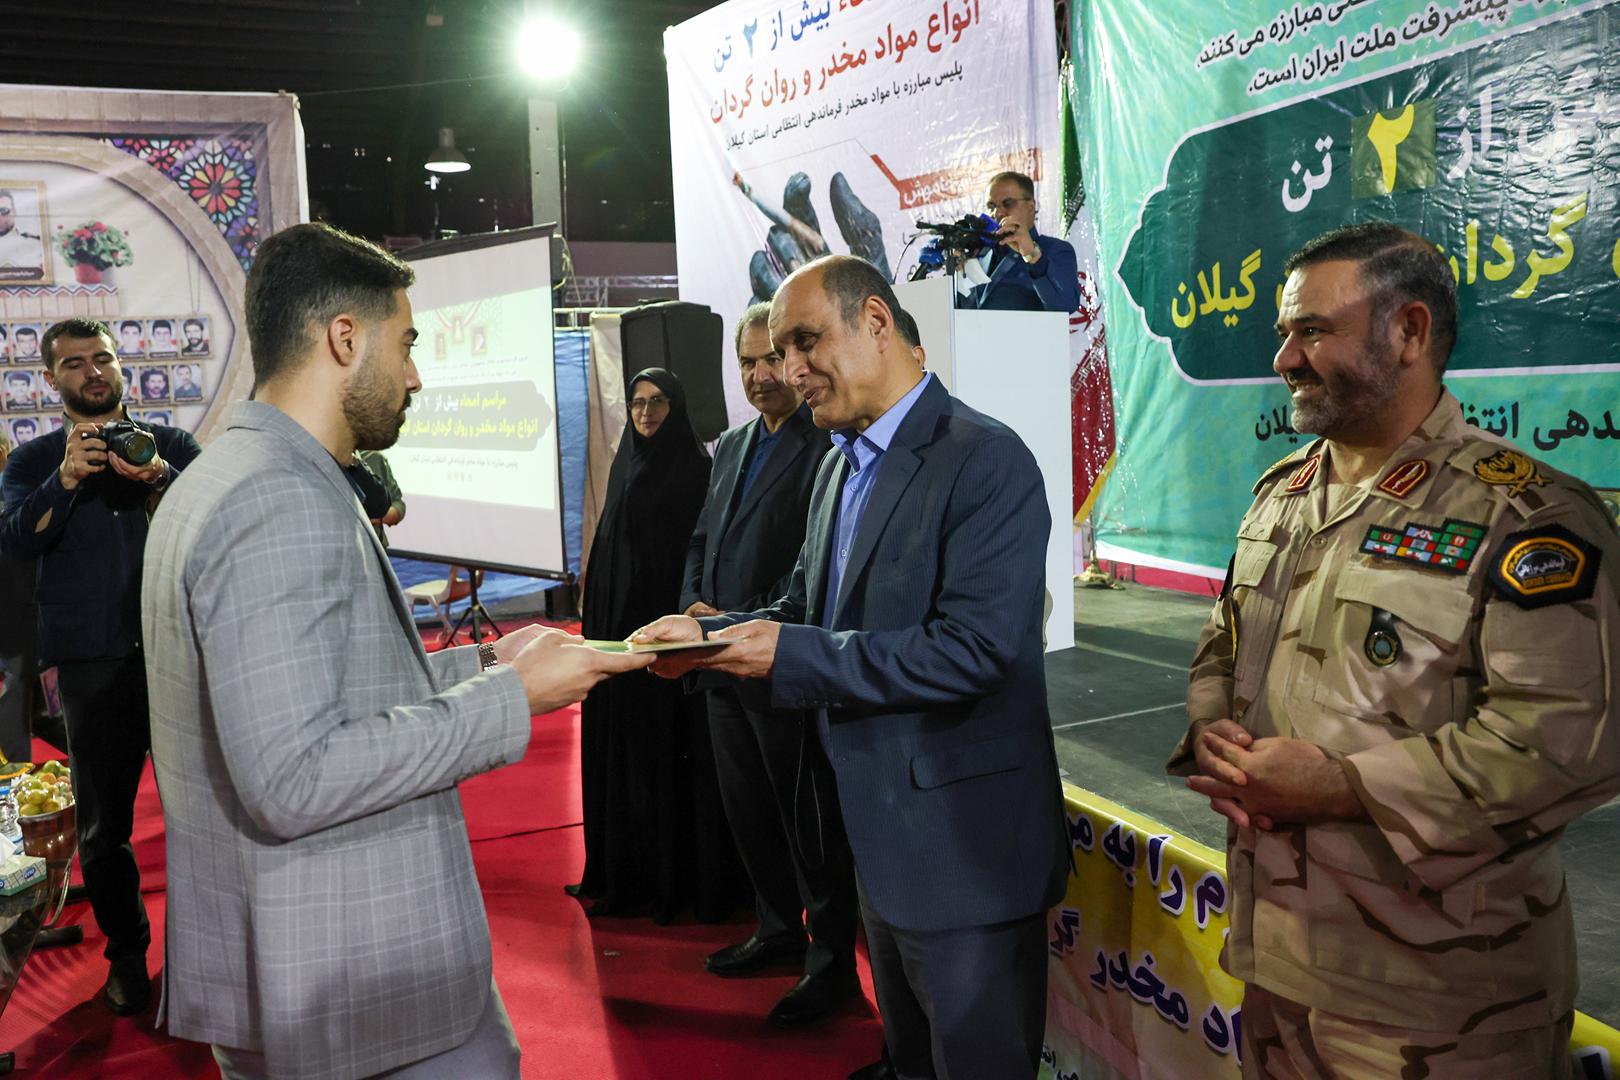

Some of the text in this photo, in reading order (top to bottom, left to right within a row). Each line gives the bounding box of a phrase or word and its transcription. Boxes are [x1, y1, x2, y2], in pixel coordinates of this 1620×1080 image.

[714, 0, 830, 72] بیش از ۲ تن
[1239, 28, 1265, 54] می
[1269, 7, 1323, 43] مبارزه
[1302, 41, 1345, 78] ایران
[1350, 28, 1395, 58] ملت
[710, 0, 980, 124] انواع مواد مخدر و روان گردان
[934, 60, 963, 87] پلیس
[1249, 60, 1297, 92] است.
[871, 90, 890, 103] مواد
[893, 82, 901, 96] با
[904, 73, 931, 95] مبارزه
[804, 103, 843, 129] فرماندهی
[845, 93, 868, 116] مخدر
[748, 124, 768, 146] استان
[772, 113, 801, 139] انتظامی
[1447, 86, 1492, 179] از
[1367, 103, 1414, 193] ۲
[1282, 134, 1333, 211] تن
[1171, 249, 1262, 329] گیلان
[1255, 405, 1298, 444] یلان
[1149, 836, 1184, 913] را
[1091, 951, 1189, 1026] مخدر
